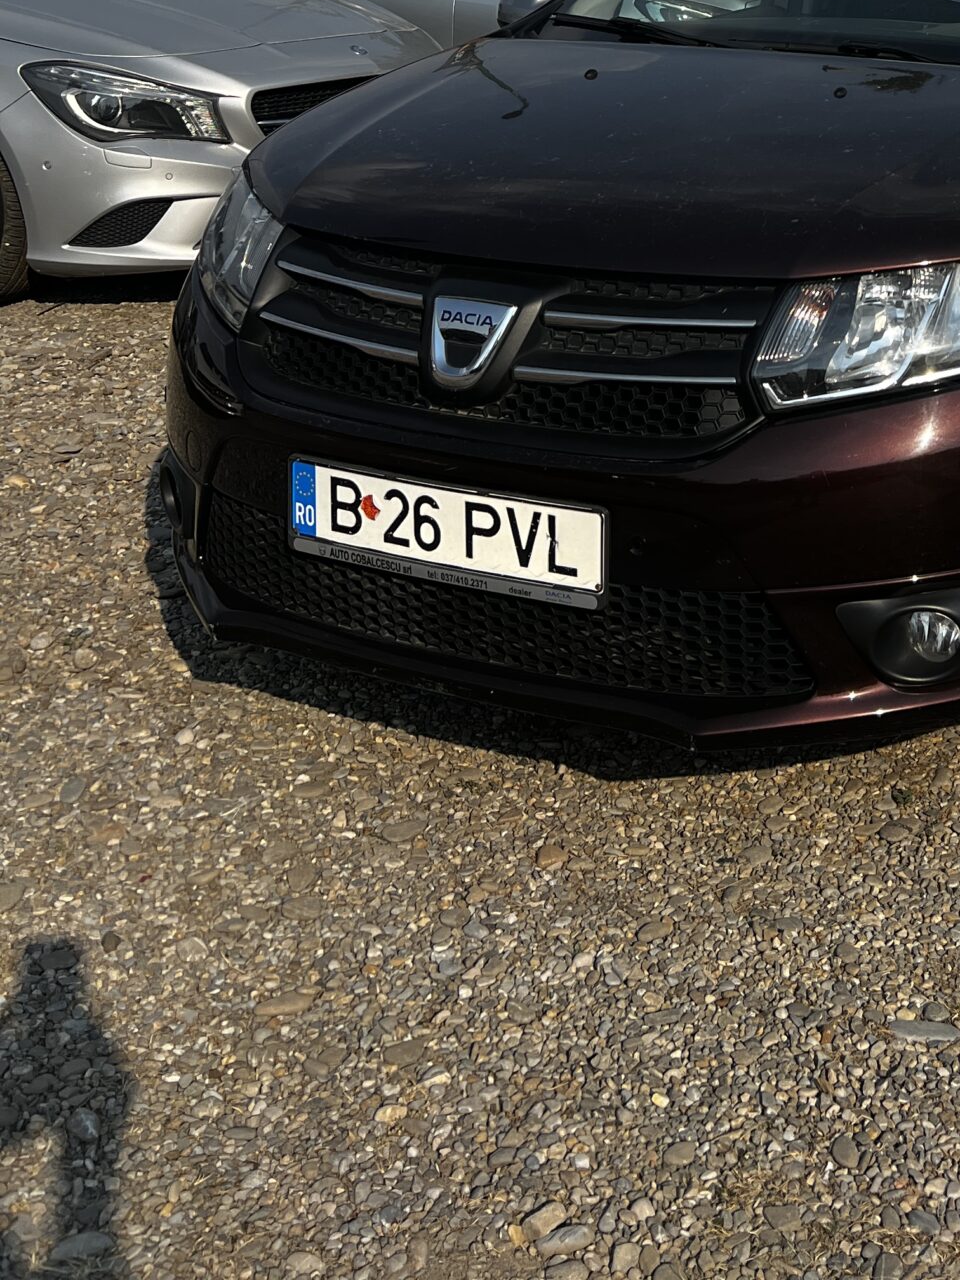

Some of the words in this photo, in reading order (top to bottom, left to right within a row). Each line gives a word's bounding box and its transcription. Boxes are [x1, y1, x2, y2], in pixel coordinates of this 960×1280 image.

[441, 310, 495, 327] DACIA
[295, 502, 315, 527] RO
[330, 475, 362, 536] B
[383, 488, 442, 552] 26
[464, 500, 578, 577] PVL
[330, 547, 350, 561] AUTO
[350, 553, 402, 573] COBALCESCU
[508, 586, 532, 597] dealer
